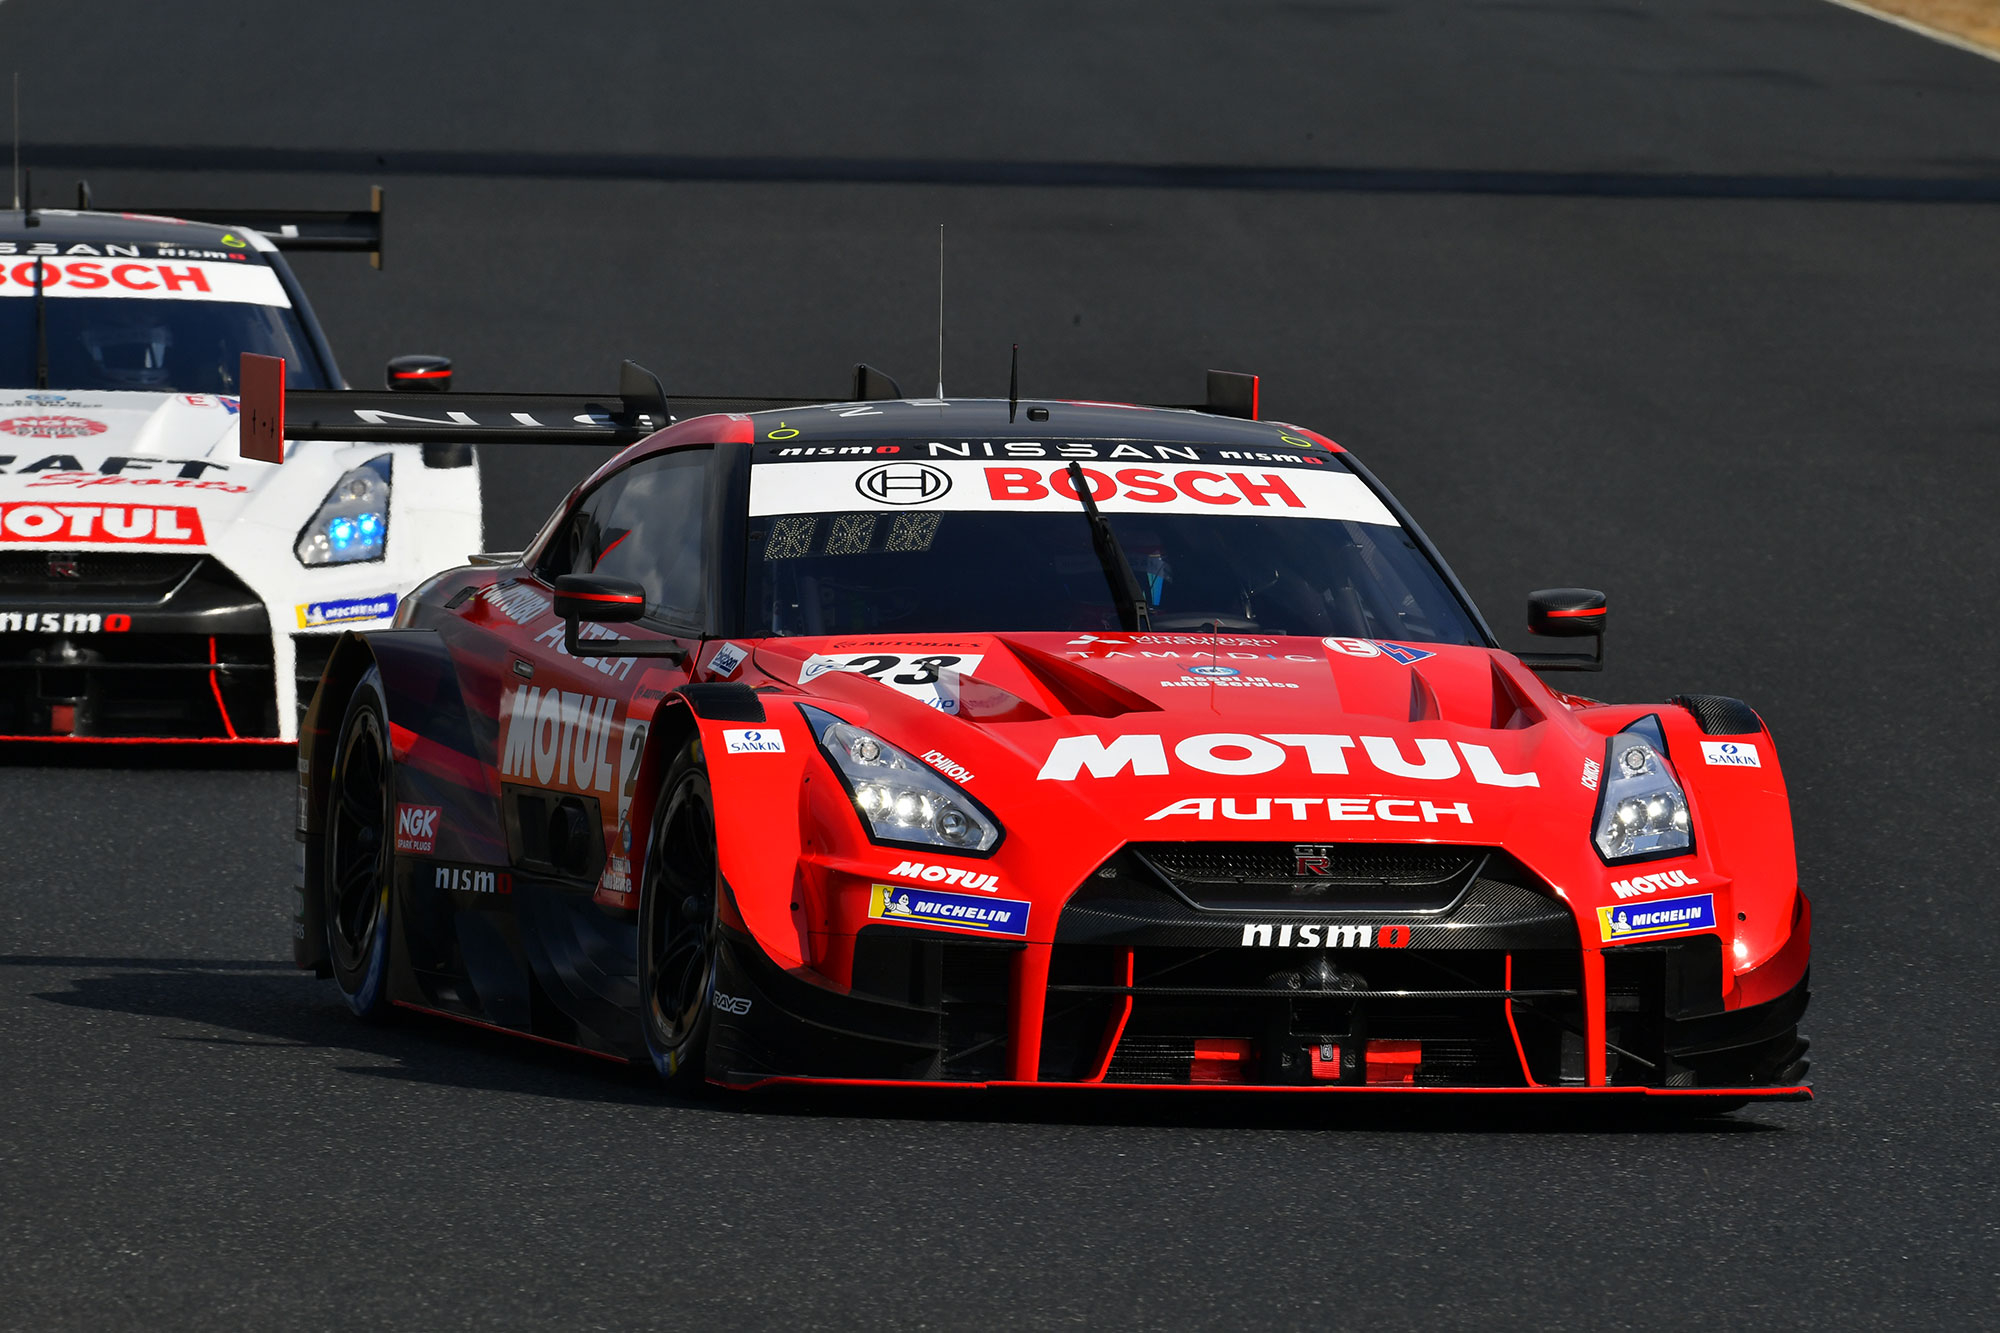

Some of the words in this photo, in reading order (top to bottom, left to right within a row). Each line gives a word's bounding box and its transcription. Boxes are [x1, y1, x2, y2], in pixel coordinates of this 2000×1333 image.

[157, 247, 246, 261] nismo
[0, 262, 212, 293] OSCH
[778, 445, 900, 456] nismo
[928, 442, 1200, 460] NISSAN
[1220, 450, 1323, 465] nismo
[983, 467, 1306, 508] BOSCH
[0, 505, 192, 540] OTUL
[325, 602, 389, 618] MICHELIN
[1129, 635, 1278, 644] MITSUBISHI
[1066, 651, 1317, 662] TAMADIC
[845, 655, 962, 685] 23
[502, 685, 617, 792] MOTUL
[731, 742, 781, 752] SANKIN
[920, 750, 974, 784] ICHIKOH
[1036, 733, 1540, 788] MOTUL
[1708, 754, 1757, 766] SANKIN
[1581, 757, 1600, 791] ICHIKOH
[398, 808, 437, 838] NGK
[1144, 797, 1475, 824] AUTECH
[398, 839, 413, 849] SPARK
[414, 840, 431, 851] PLUGS
[435, 868, 512, 894] nismo
[889, 861, 999, 893] MOTUL
[1610, 870, 1699, 899] MOTUL
[914, 901, 1011, 923] MICHELIN
[1632, 907, 1702, 926] MICHELIN
[1242, 924, 1411, 949] nismo
[713, 990, 752, 1015] RAYS
